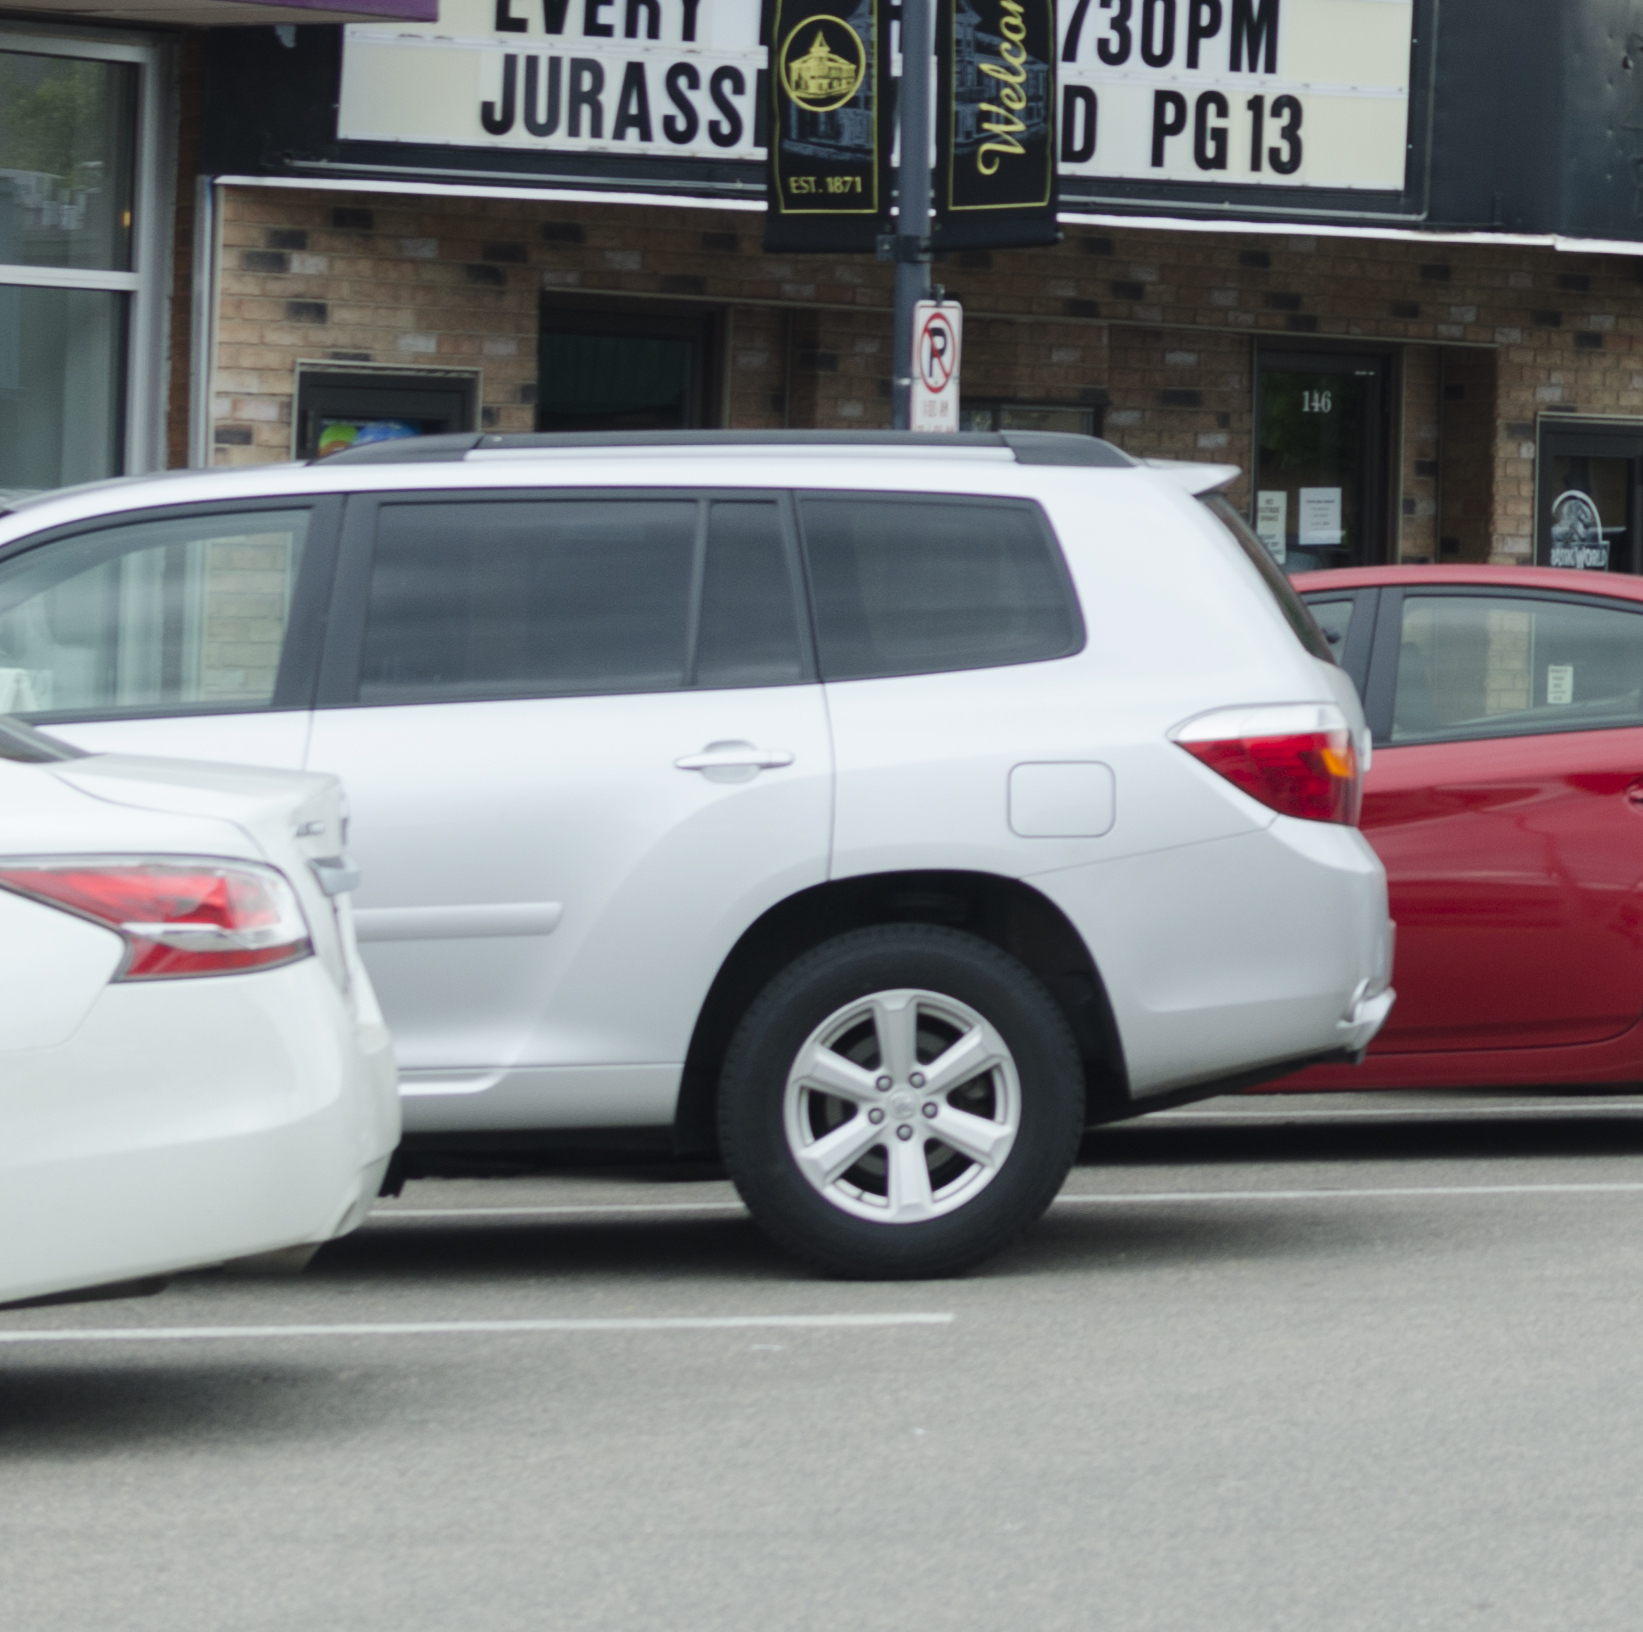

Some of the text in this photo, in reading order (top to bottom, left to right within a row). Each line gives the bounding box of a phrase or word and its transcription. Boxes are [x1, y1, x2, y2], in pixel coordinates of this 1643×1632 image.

[789, 175, 862, 194] EST. 1871
[1302, 390, 1332, 413] 146
